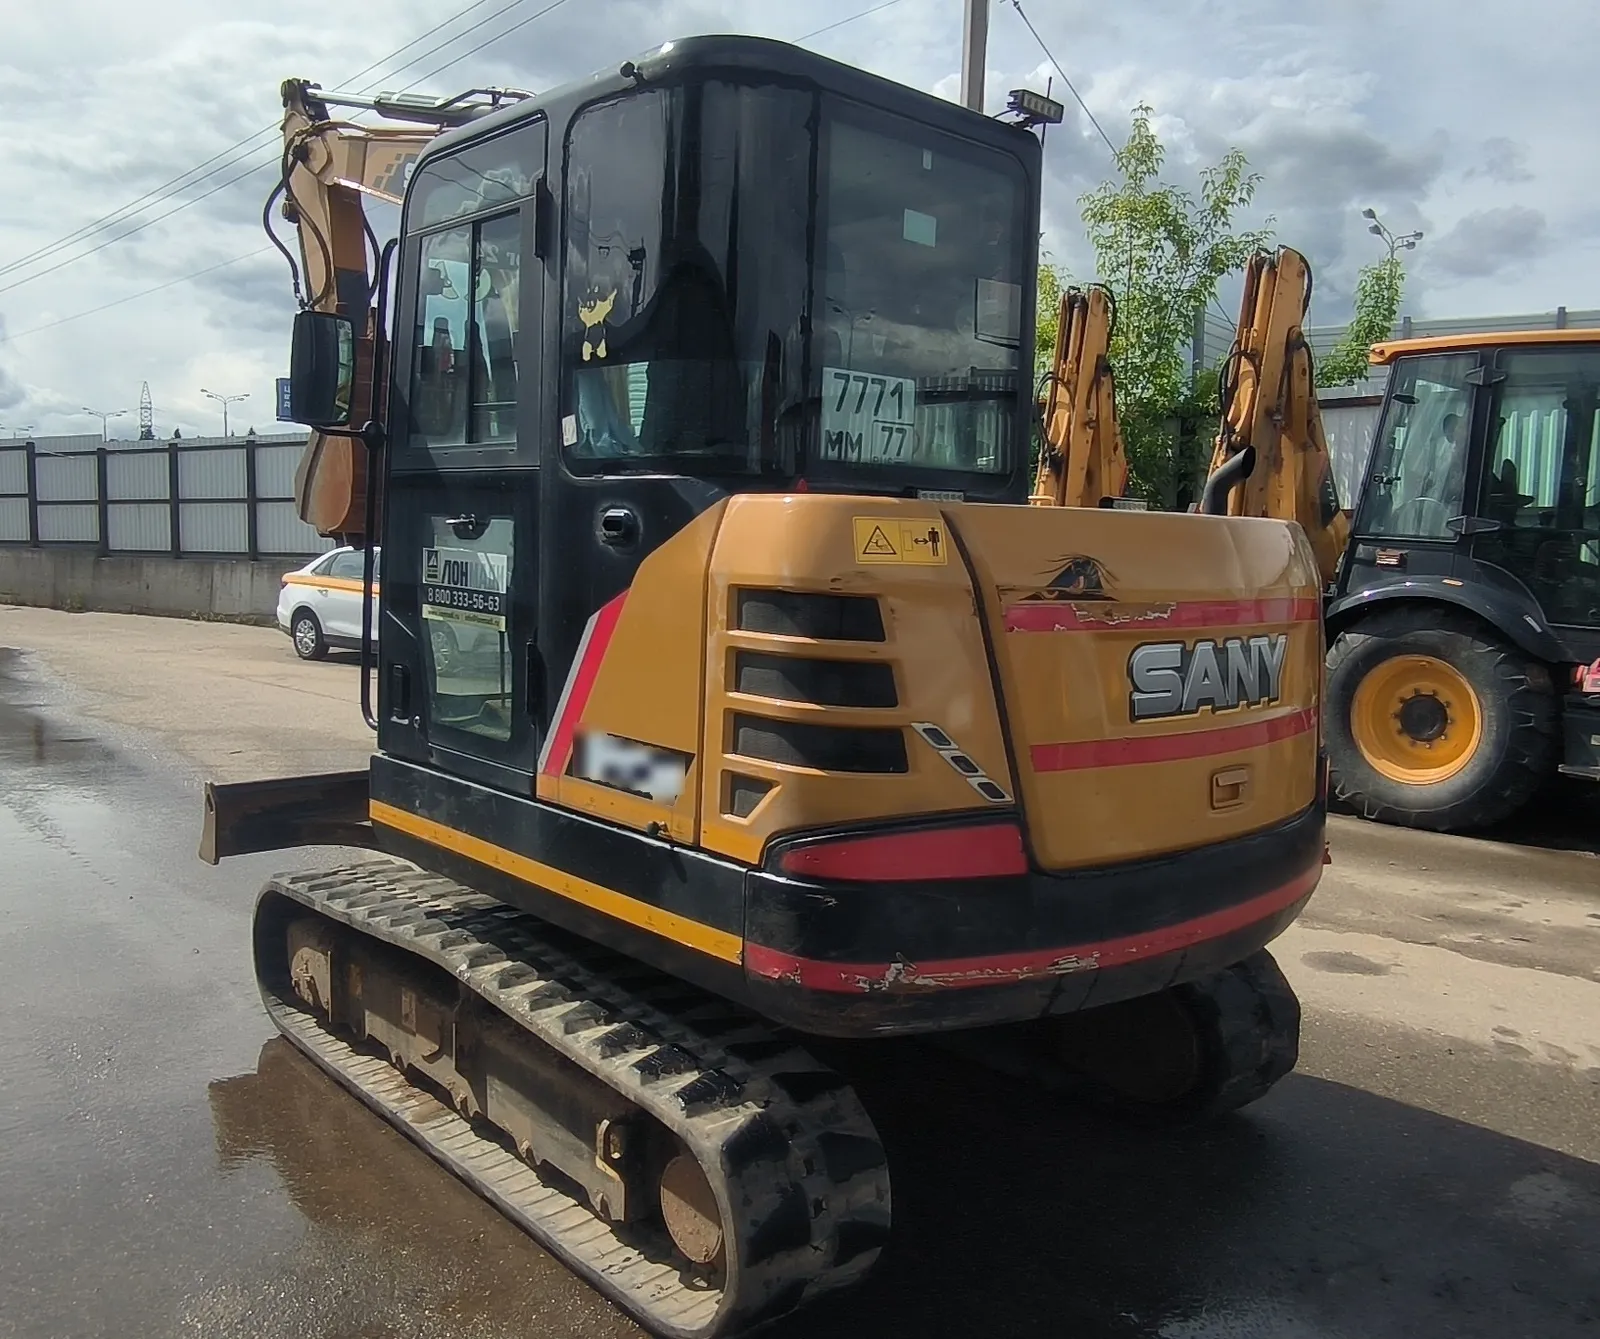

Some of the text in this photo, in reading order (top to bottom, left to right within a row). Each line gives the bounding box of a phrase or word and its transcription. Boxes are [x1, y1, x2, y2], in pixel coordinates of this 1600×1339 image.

[833, 372, 904, 420] 7771
[880, 425, 907, 457] 77
[427, 587, 500, 611] 8 800 333-56-63
[1129, 634, 1287, 720] SANY
